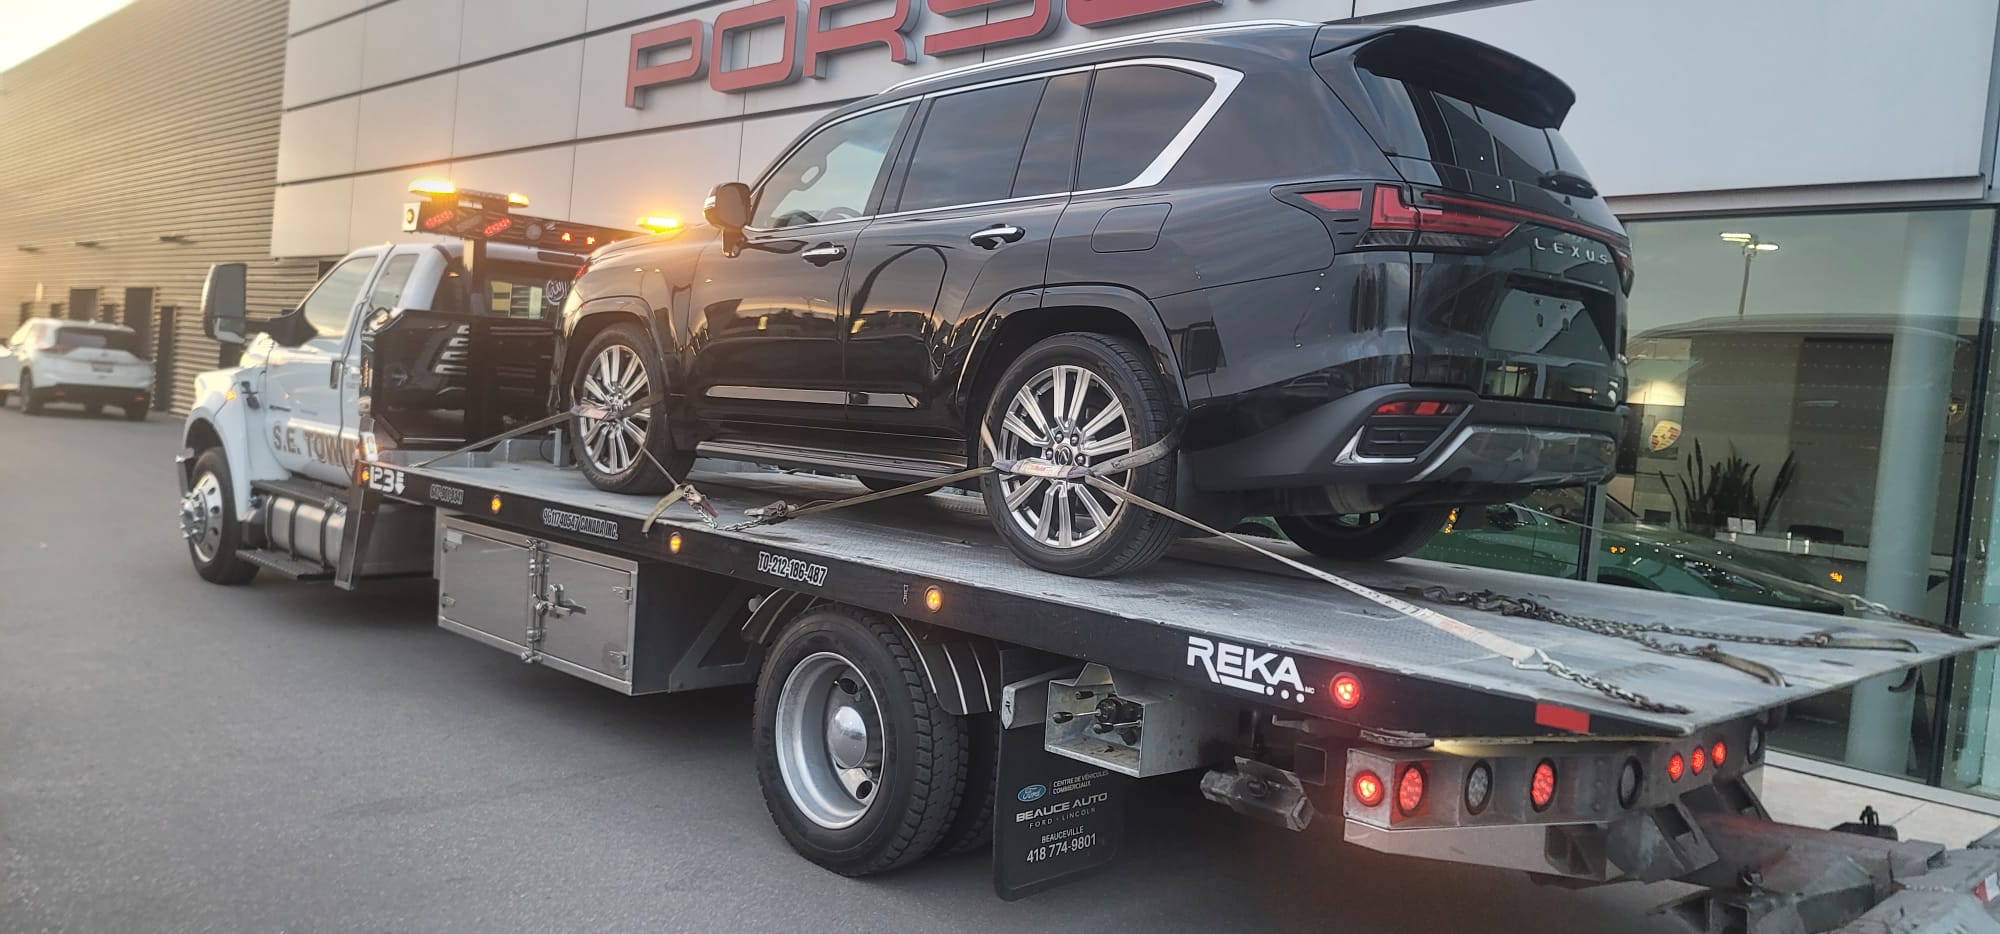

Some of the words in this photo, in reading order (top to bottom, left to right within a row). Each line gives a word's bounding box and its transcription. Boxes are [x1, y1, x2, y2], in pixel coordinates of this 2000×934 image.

[626, 0, 1224, 110] PORS
[1533, 236, 1609, 265] LEXUS
[272, 423, 302, 455] S.E.
[579, 515, 606, 538] CANADA
[604, 520, 619, 540] INC.
[1186, 636, 1306, 693] REKA
[1020, 786, 1044, 801] Ford
[1052, 780, 1092, 795] COMMERCIAUX
[1053, 777, 1074, 788] CENTRE
[1074, 775, 1082, 783] DE
[1016, 801, 1070, 823] BEAUCE
[1072, 792, 1108, 809] AUTO
[1029, 818, 1053, 830] FORD
[1062, 807, 1097, 821] LINCOLN
[1041, 825, 1084, 844] BEAUCEVILLE
[1026, 847, 1046, 864] 418
[1048, 833, 1097, 859] 774-9801
